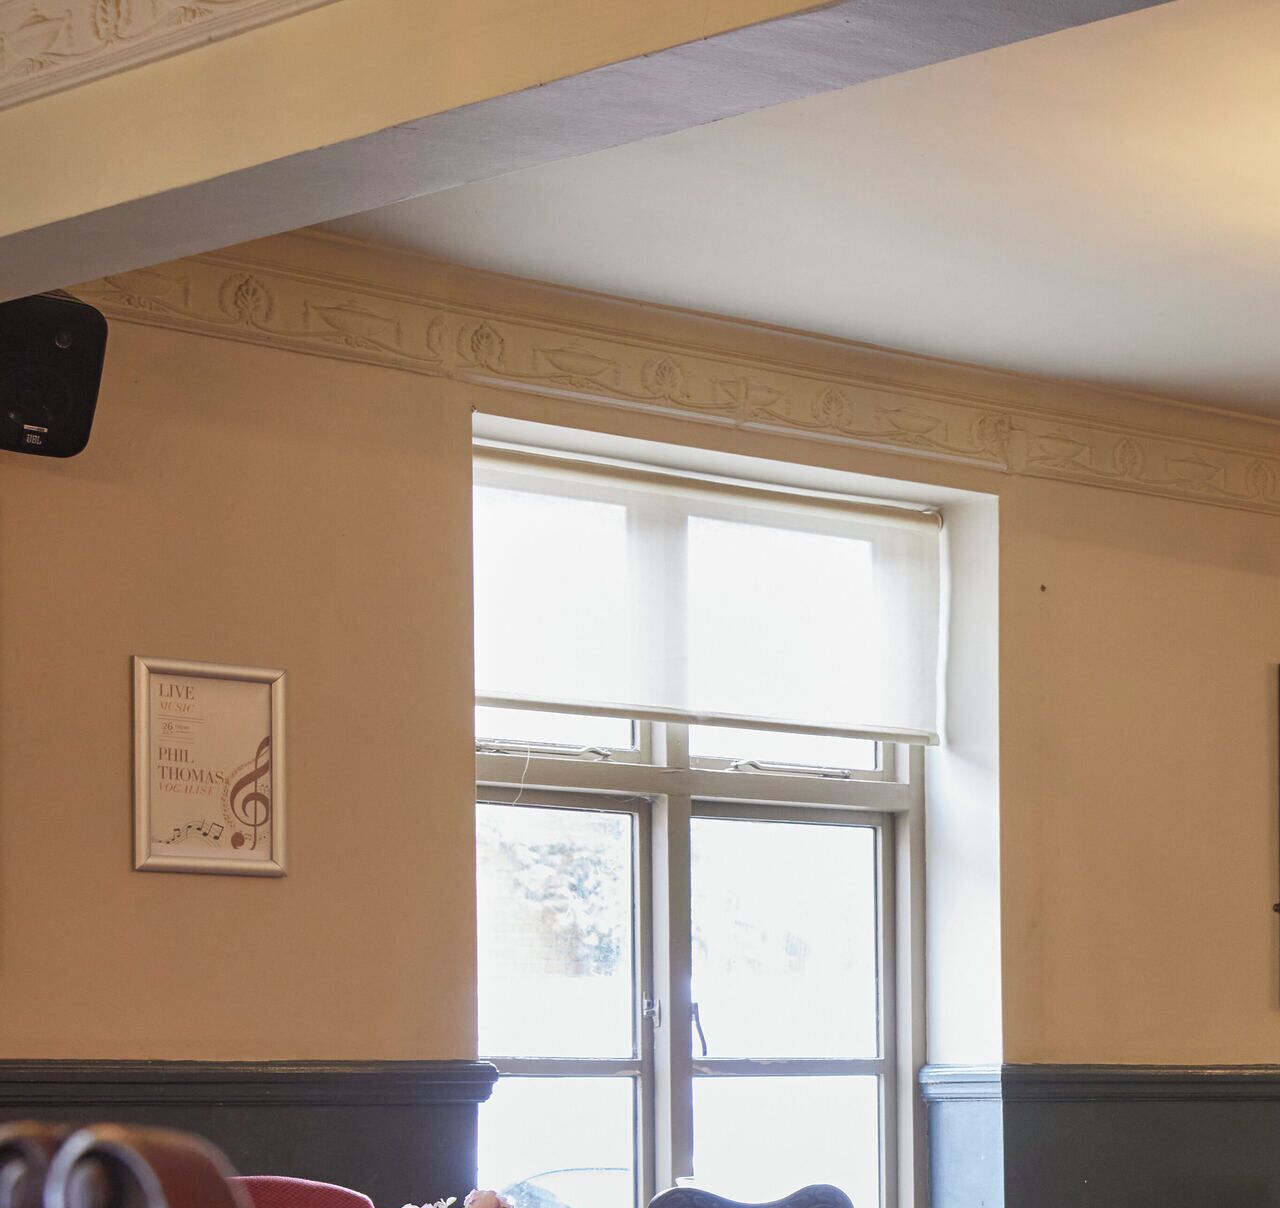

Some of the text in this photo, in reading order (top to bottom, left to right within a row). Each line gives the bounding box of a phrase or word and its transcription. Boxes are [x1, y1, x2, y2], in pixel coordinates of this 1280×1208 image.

[159, 683, 195, 700] LIVE
[159, 701, 195, 714] MUSIC
[162, 722, 173, 730] 26
[159, 747, 195, 763] PHIL
[158, 765, 224, 784] THOMAS
[159, 783, 214, 795] VOCALIST
